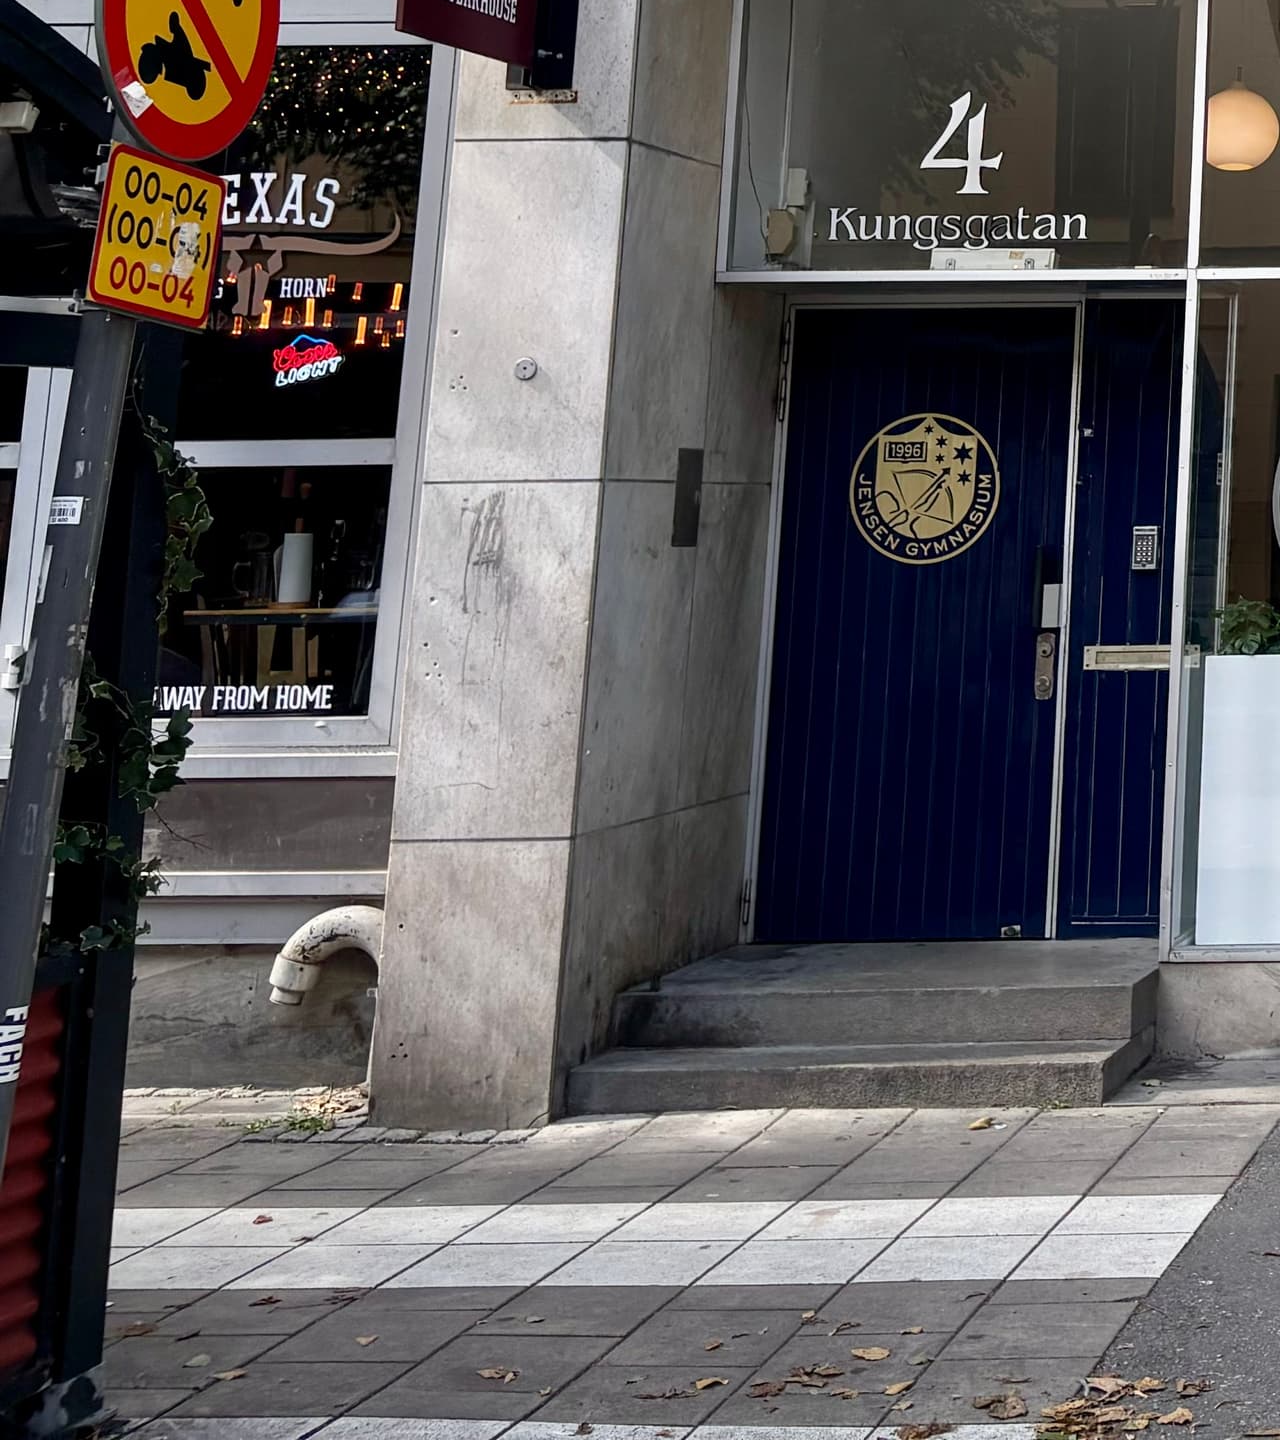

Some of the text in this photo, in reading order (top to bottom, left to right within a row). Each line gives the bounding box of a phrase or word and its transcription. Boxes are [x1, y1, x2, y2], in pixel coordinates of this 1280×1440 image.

[919, 91, 1003, 194] 4
[124, 165, 208, 221] 00-04
[107, 203, 211, 271] (00-)
[827, 206, 1088, 251] Kungsgatan
[109, 255, 194, 309] 00-04
[279, 277, 328, 299] HORN
[275, 356, 345, 387] LIGHT
[891, 443, 921, 457] 1996
[858, 473, 992, 557] JENSEN GYMNASIUM
[212, 685, 269, 711] FROM
[275, 684, 334, 710] HOME
